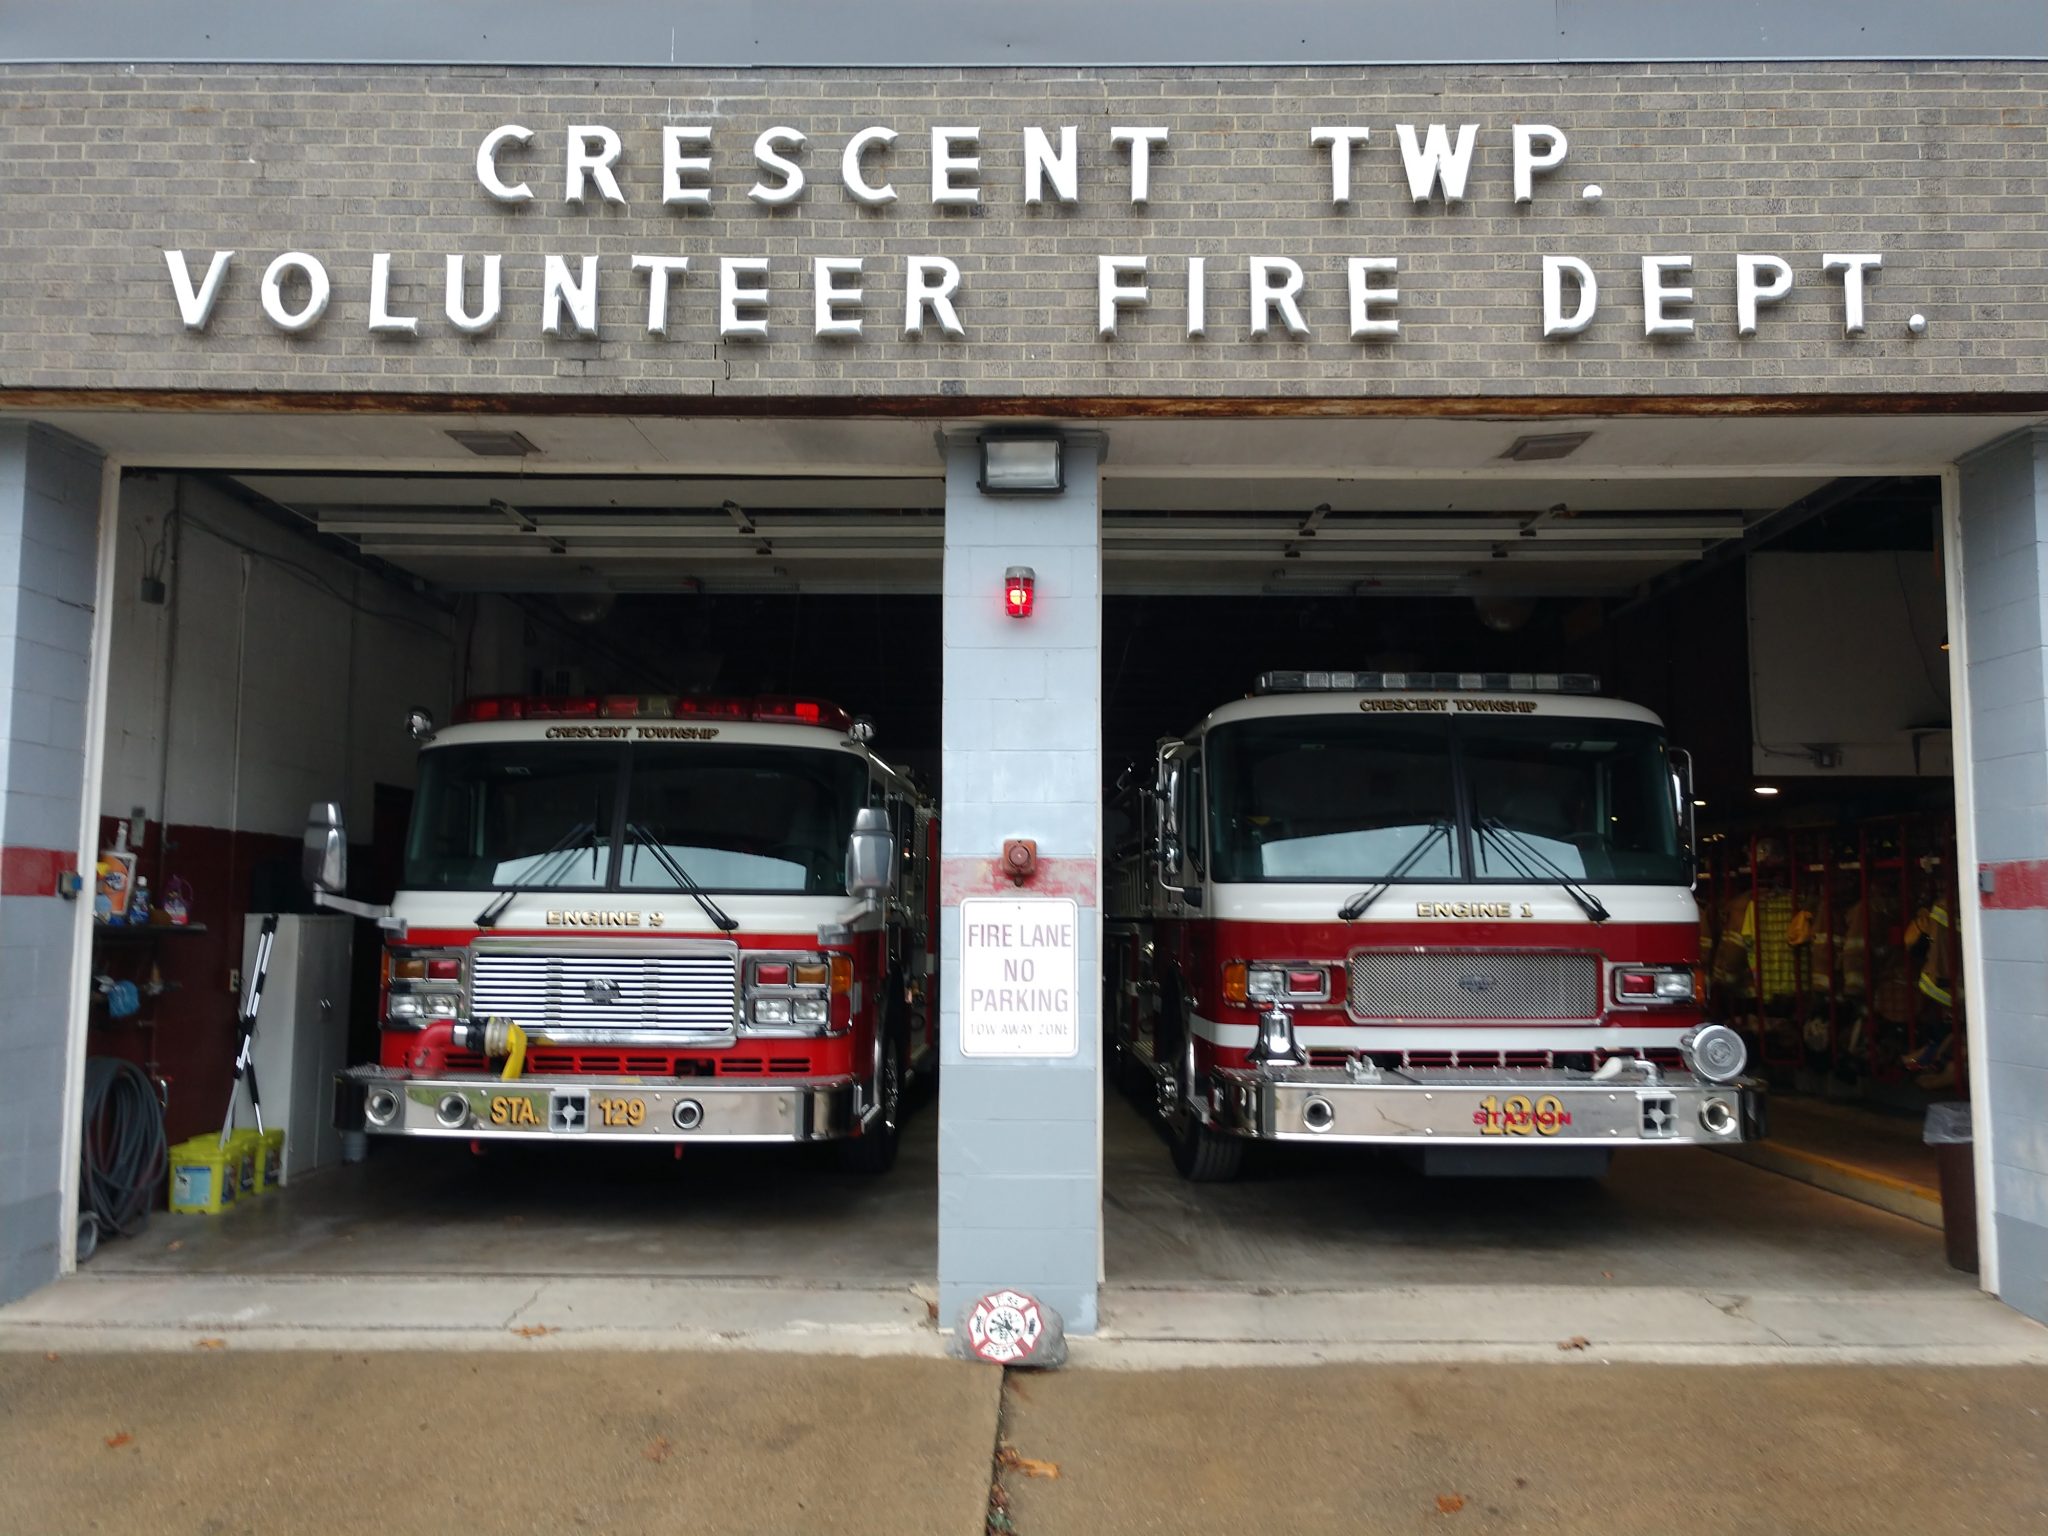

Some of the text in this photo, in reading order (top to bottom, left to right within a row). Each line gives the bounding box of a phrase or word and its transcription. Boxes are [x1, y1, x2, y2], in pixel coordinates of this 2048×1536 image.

[475, 122, 1604, 206] CRESCENT TWP.
[162, 248, 1928, 338] VOLUNTEER FIRE DEPT.
[1359, 698, 1538, 713] CRESCENT TOWNSHIP
[545, 725, 720, 740] CRESCENT TOWNSHIP
[546, 909, 641, 926] ENGINE
[1416, 901, 1534, 918] ENGINE 1
[968, 923, 1072, 948] FIRE LANE
[1003, 958, 1035, 983] NO
[970, 987, 1069, 1013] PARKING
[1000, 1023, 1033, 1036] AWAY
[490, 1095, 647, 1127] STA. 129
[1472, 1110, 1573, 1126] STATION
[1480, 1094, 1565, 1137] 129
